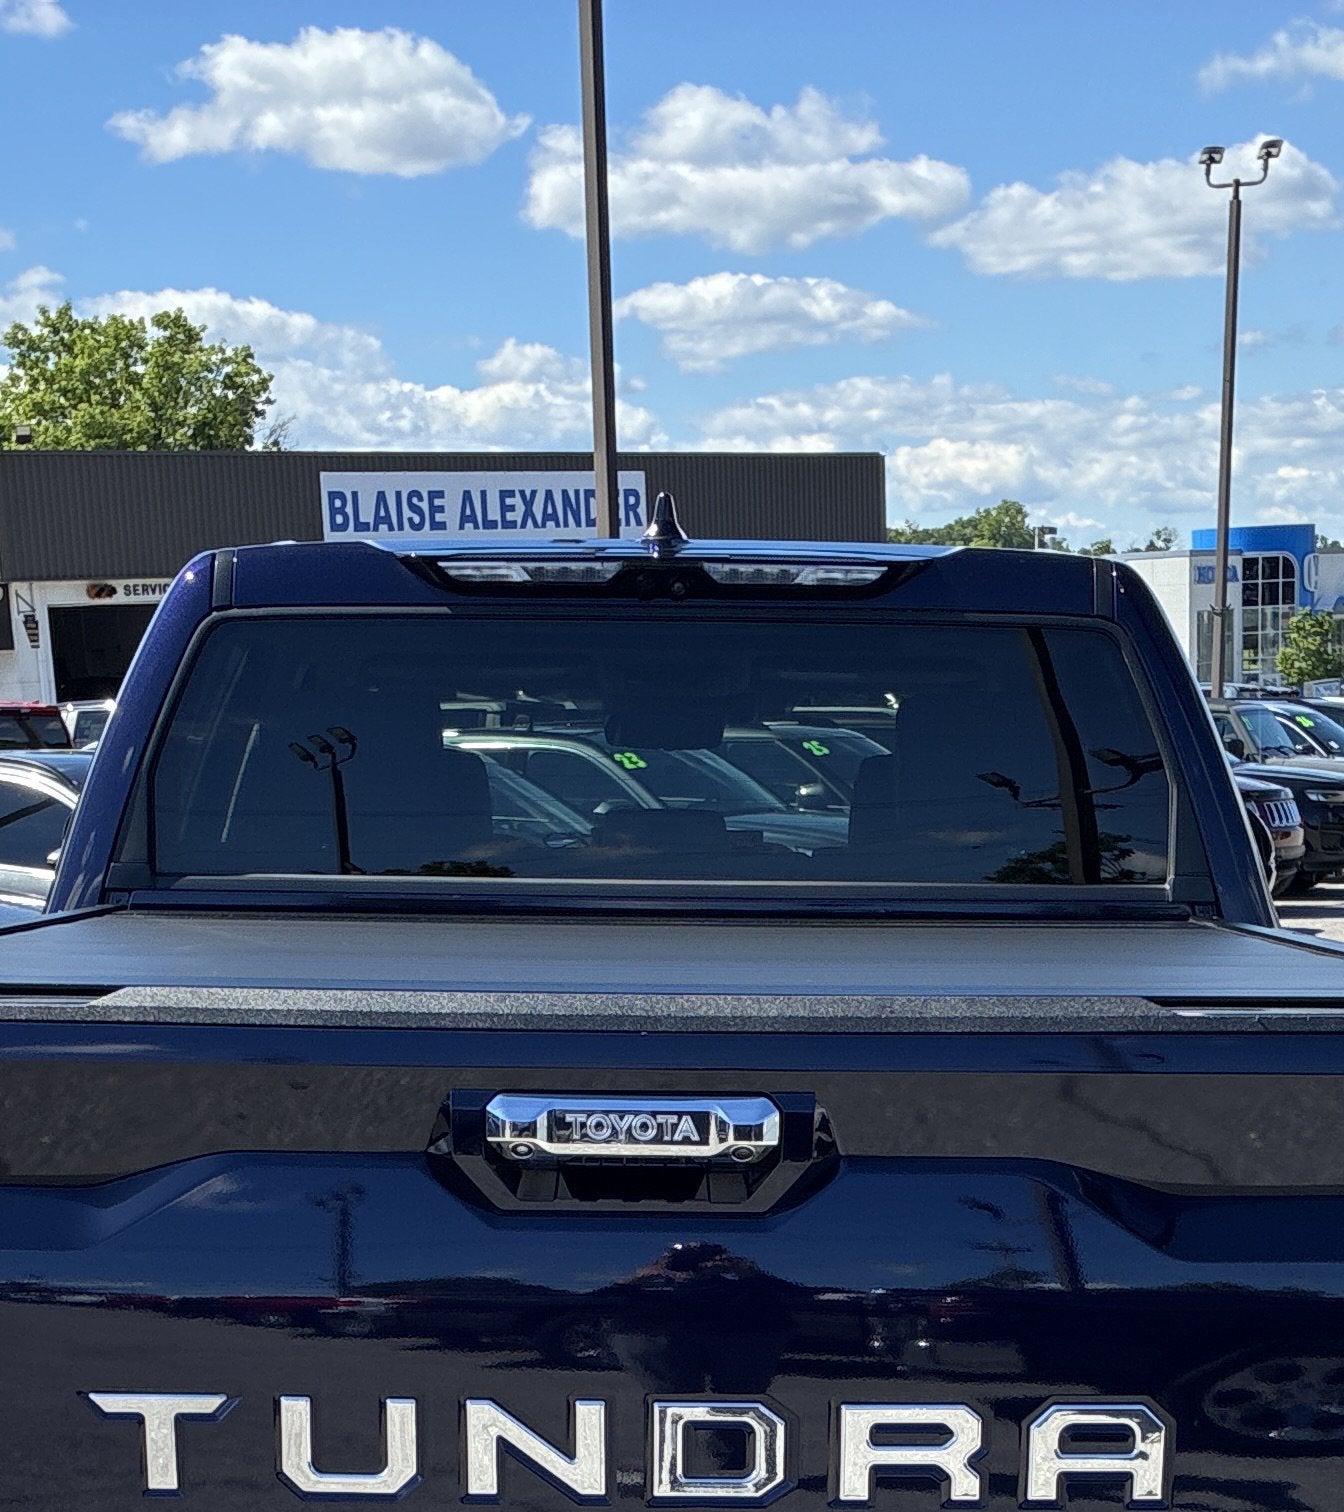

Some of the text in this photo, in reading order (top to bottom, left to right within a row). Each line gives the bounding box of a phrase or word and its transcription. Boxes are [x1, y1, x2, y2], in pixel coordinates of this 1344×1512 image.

[326, 488, 645, 533] BLAISE ALEXANDR
[564, 1113, 701, 1142] TOYOTA
[86, 1391, 1171, 1507] TUNDRA
